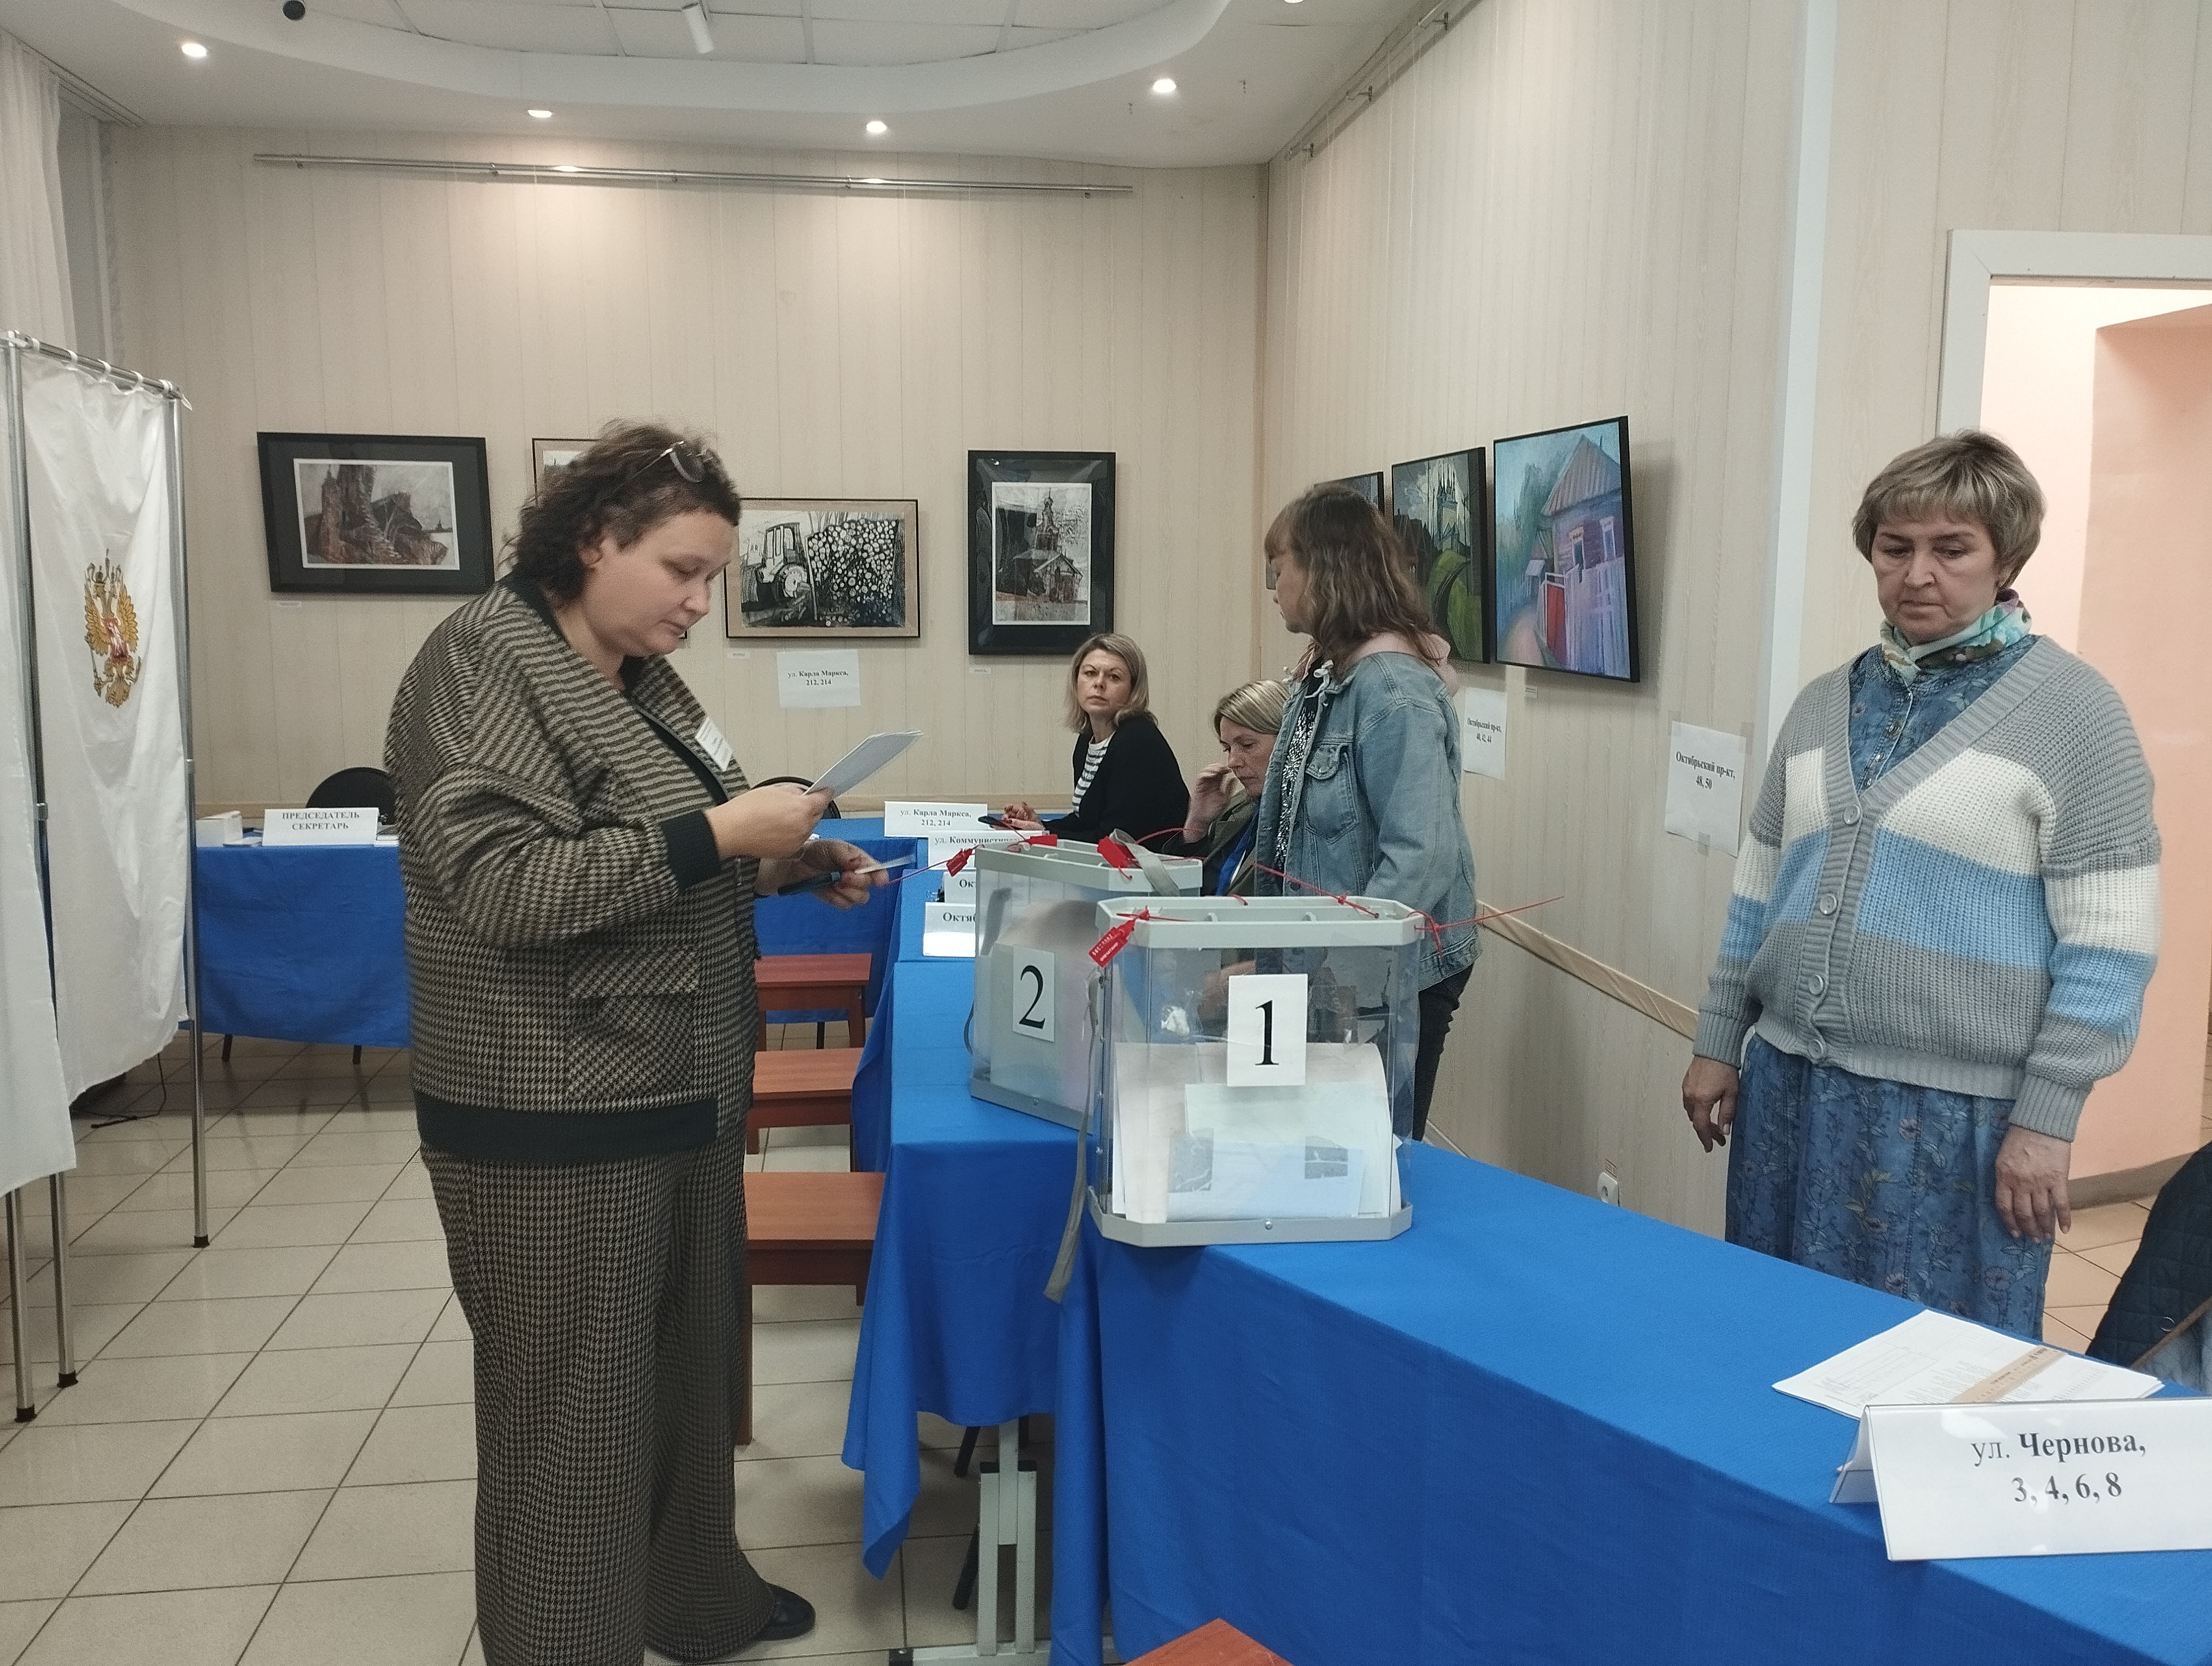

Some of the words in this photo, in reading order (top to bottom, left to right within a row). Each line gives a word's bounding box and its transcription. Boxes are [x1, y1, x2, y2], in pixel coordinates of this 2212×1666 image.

[1676, 751, 1715, 772] Октябрьский
[1716, 765, 1735, 780] пр-кт,
[1695, 775, 1704, 787] 48,
[1705, 778, 1712, 790] 50
[282, 812, 359, 821] ПРЕДСЕДАТЕЛЬ
[914, 809, 937, 817] Карла
[940, 810, 972, 818] Маркса,
[1019, 964, 1046, 1030] 2
[1255, 999, 1279, 1066] 1
[1971, 1442, 2010, 1467] ул.
[2017, 1432, 2146, 1463] Чернова,
[2011, 1477, 2037, 1506] 3,
[2044, 1475, 2069, 1505] 4,
[2075, 1473, 2100, 1504] 6,
[2105, 1472, 2122, 1497] 8
